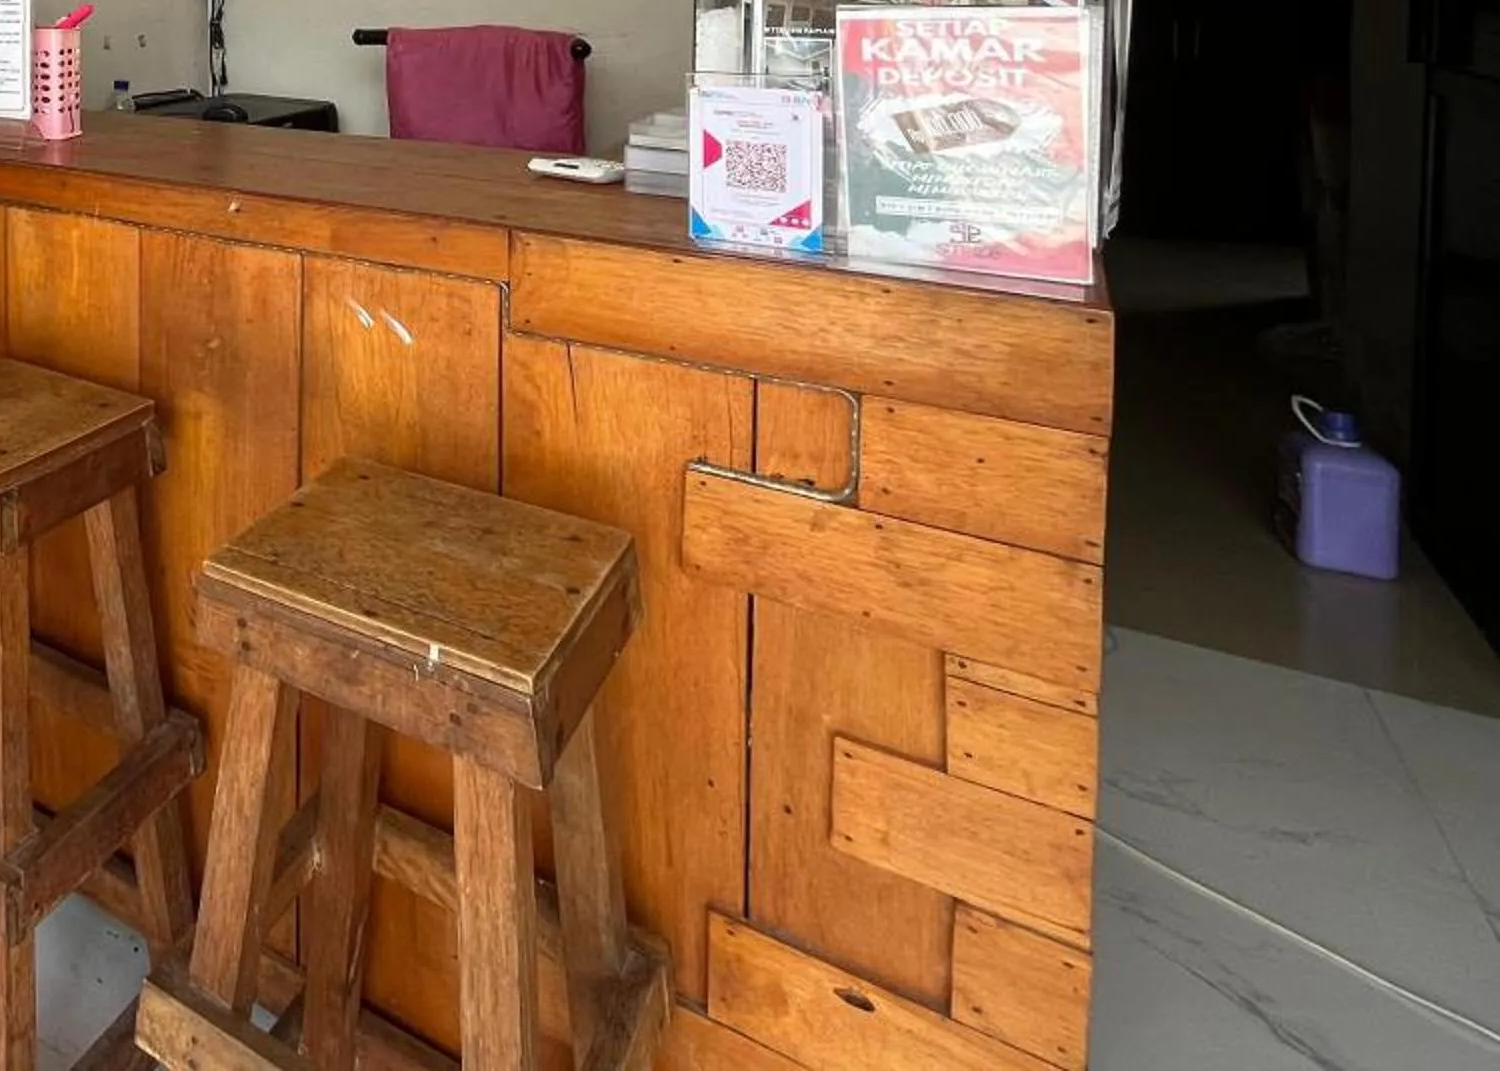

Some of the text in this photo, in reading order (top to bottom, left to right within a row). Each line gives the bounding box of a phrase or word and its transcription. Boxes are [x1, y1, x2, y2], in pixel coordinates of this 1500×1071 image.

[897, 18, 1009, 38] SETIAP
[860, 36, 1047, 64] KAMAR
[877, 66, 1030, 88] DEPOSIT
